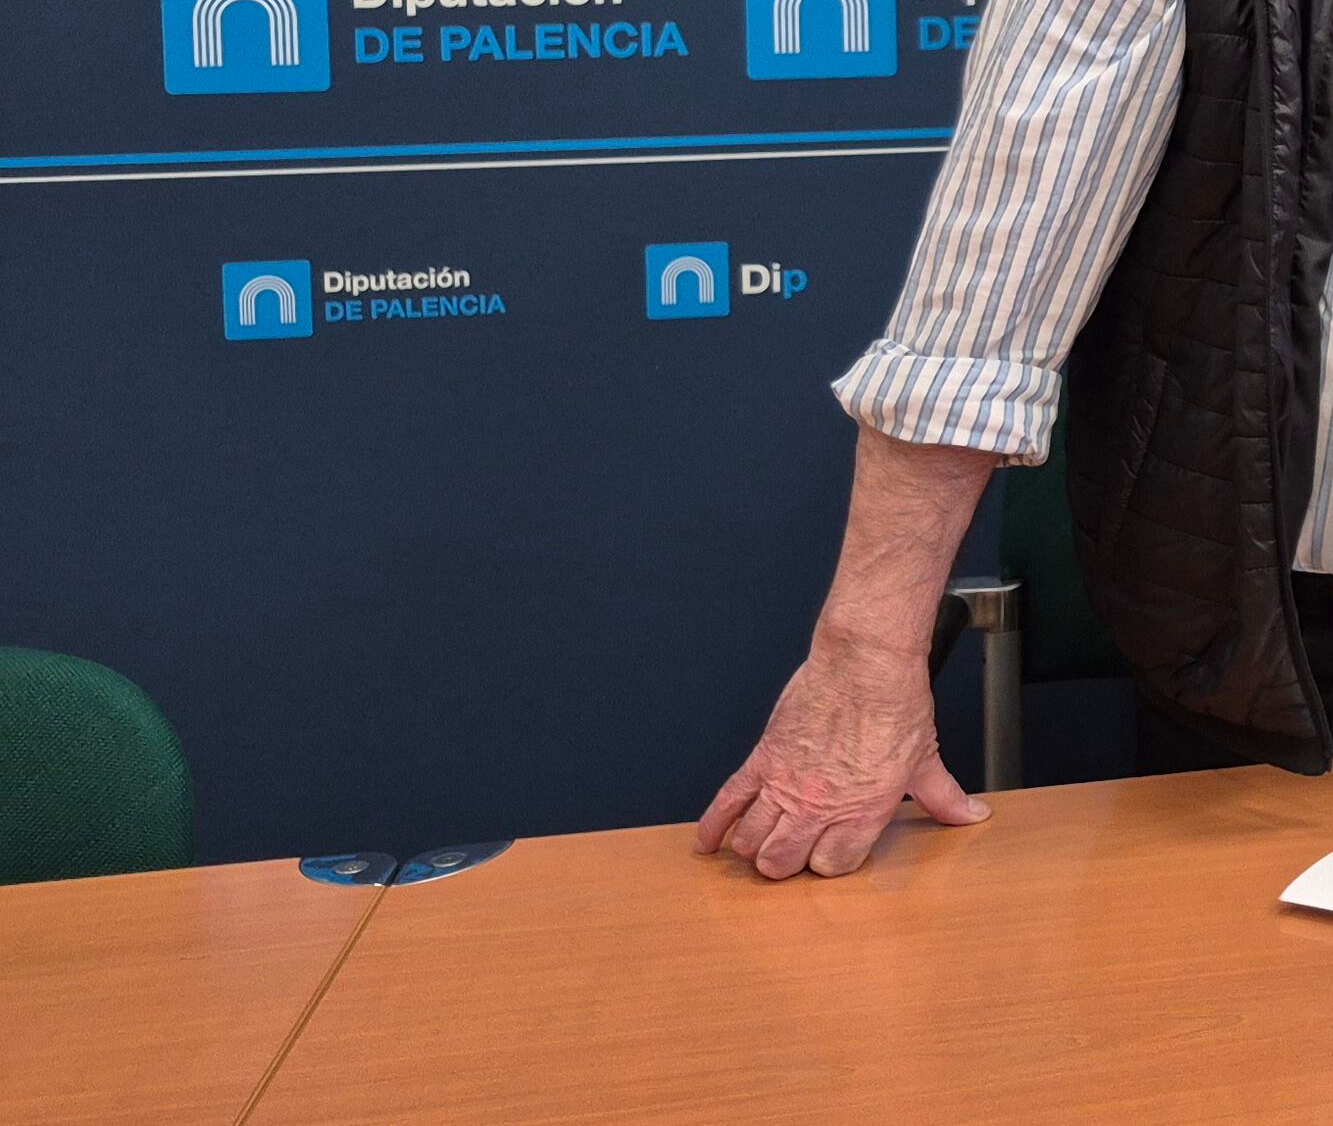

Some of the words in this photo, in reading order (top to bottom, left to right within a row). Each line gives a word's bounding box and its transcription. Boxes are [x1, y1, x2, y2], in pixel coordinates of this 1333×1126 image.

[354, 27, 425, 64] DE
[440, 22, 689, 62] PALENCIA
[323, 266, 471, 297] Diputación
[741, 262, 808, 299] Dip
[325, 299, 364, 323] DE
[370, 293, 507, 320] PALENCIA
